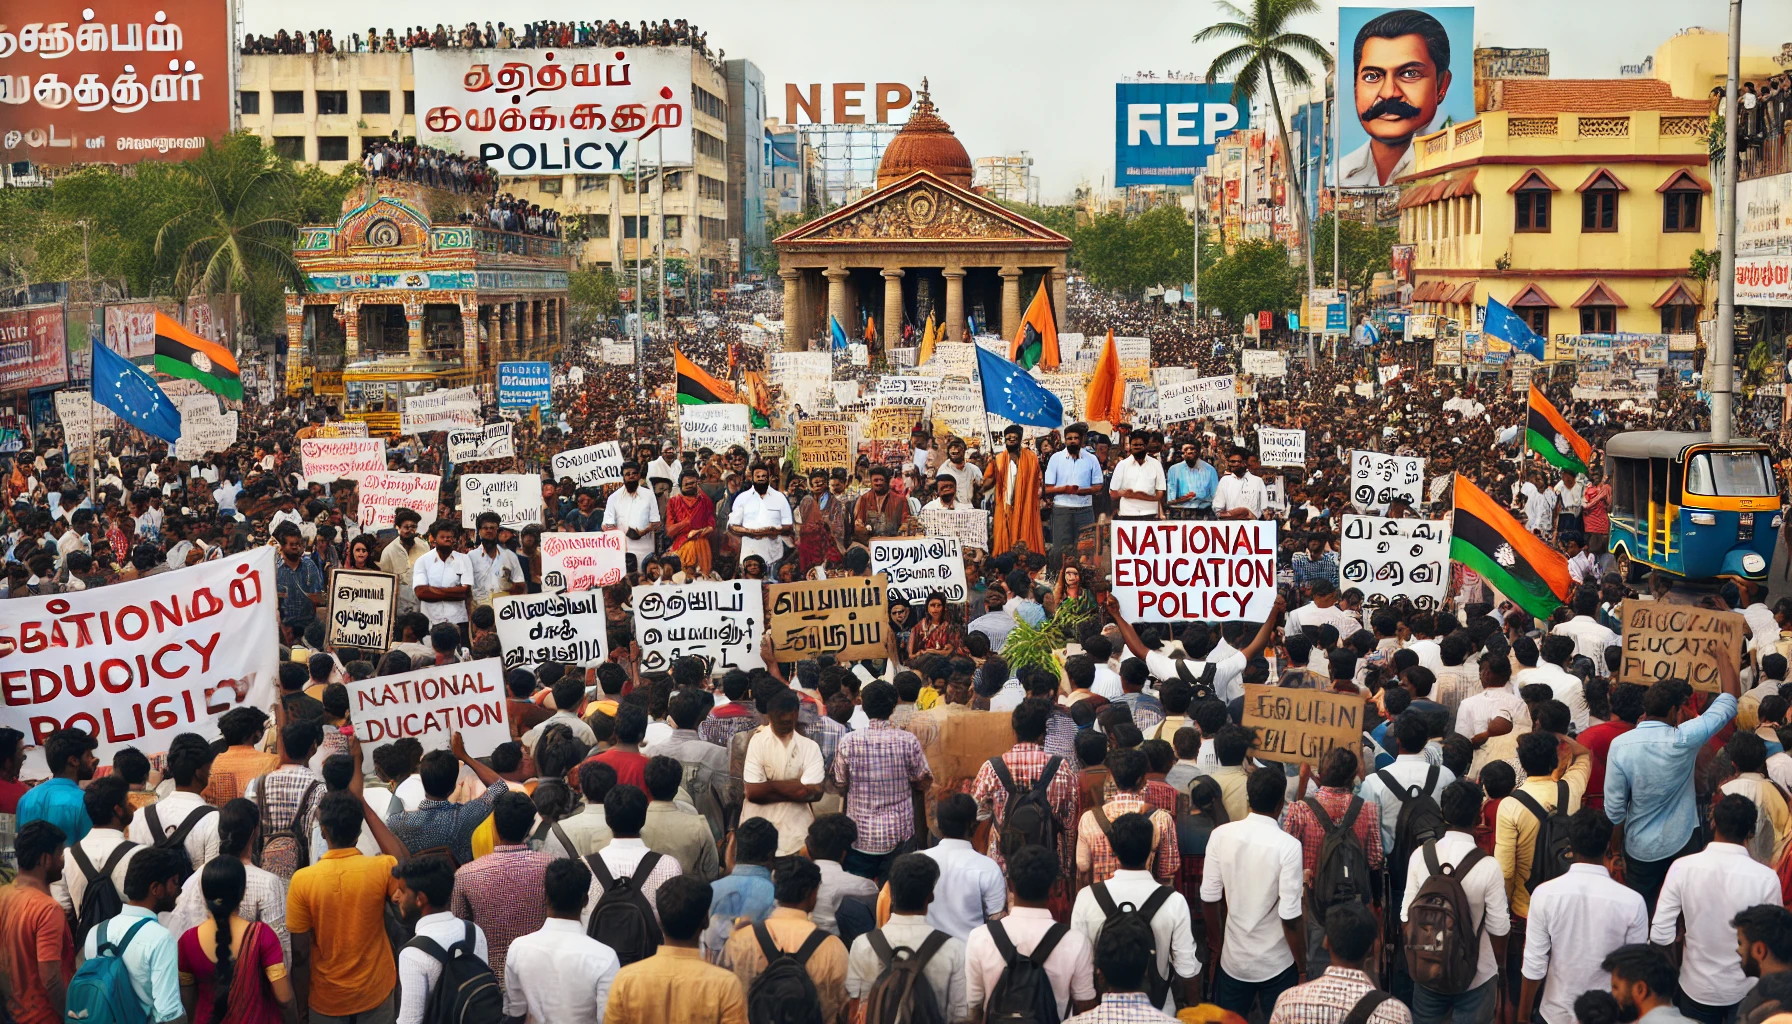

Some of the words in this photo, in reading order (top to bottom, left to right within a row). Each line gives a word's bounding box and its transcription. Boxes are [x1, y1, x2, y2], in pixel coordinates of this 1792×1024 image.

[785, 82, 913, 125] NEP
[1117, 524, 1273, 555] NATIONAL
[1115, 557, 1274, 588] EDUCATION
[1137, 590, 1254, 618] POLICY
[357, 671, 496, 712] NATIONAL
